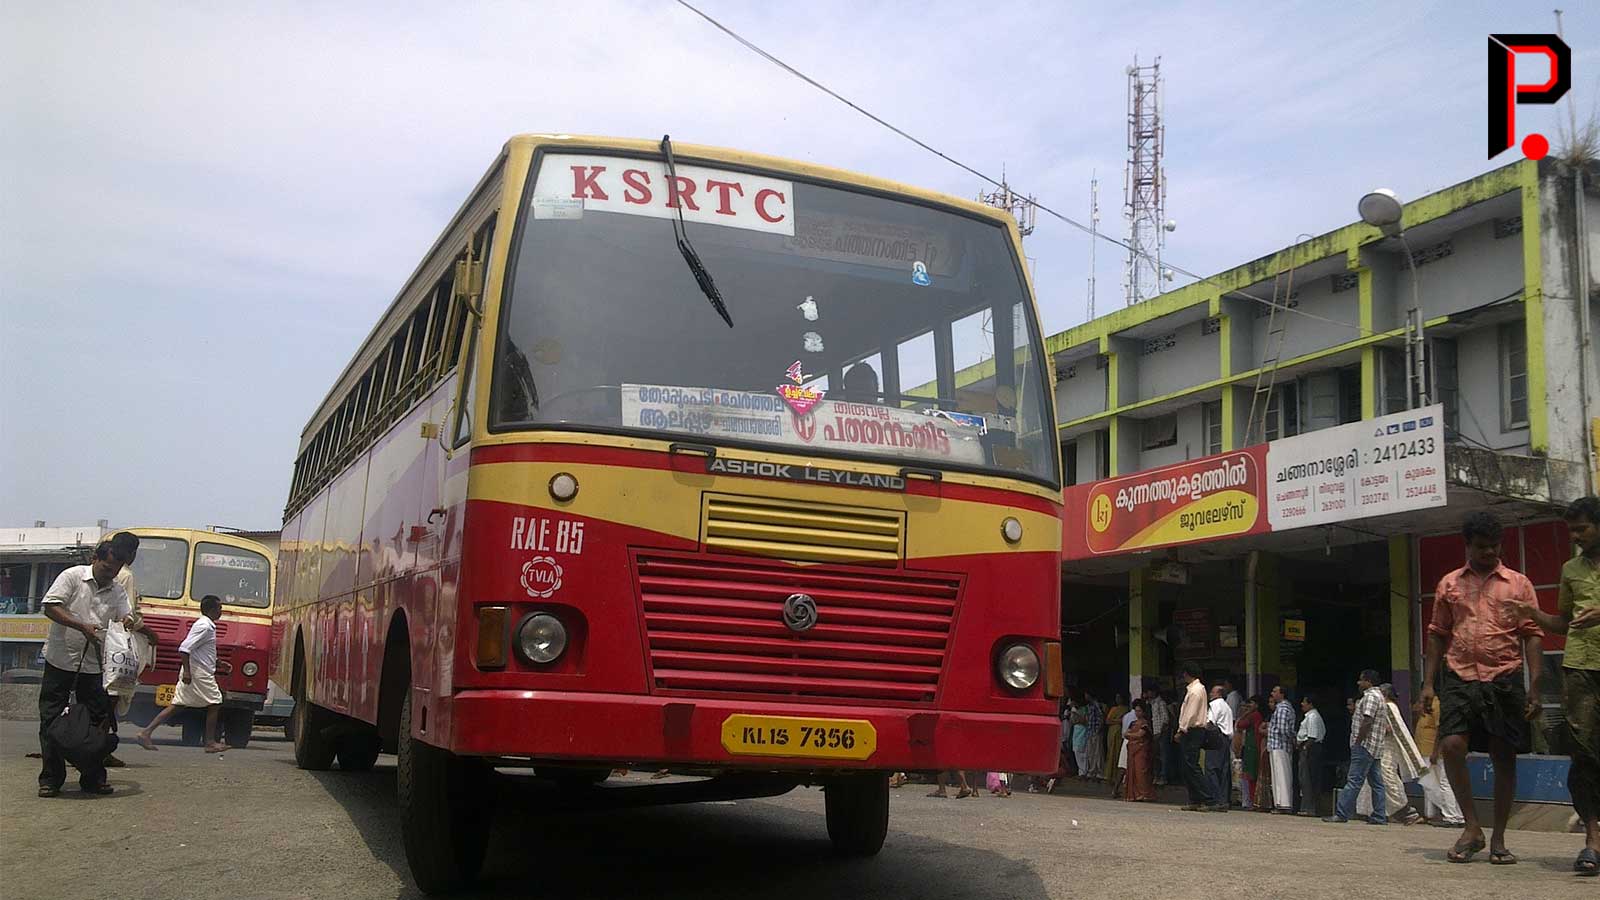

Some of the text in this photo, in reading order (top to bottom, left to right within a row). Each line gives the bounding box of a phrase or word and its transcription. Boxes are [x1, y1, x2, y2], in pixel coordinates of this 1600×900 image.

[571, 166, 786, 223] KSRTC
[1373, 437, 1435, 464] 2412433
[710, 459, 905, 489] ASHOK LEYLAND
[511, 517, 584, 555] RAE 85
[529, 569, 554, 584] TVLA
[800, 727, 855, 750] 7356
